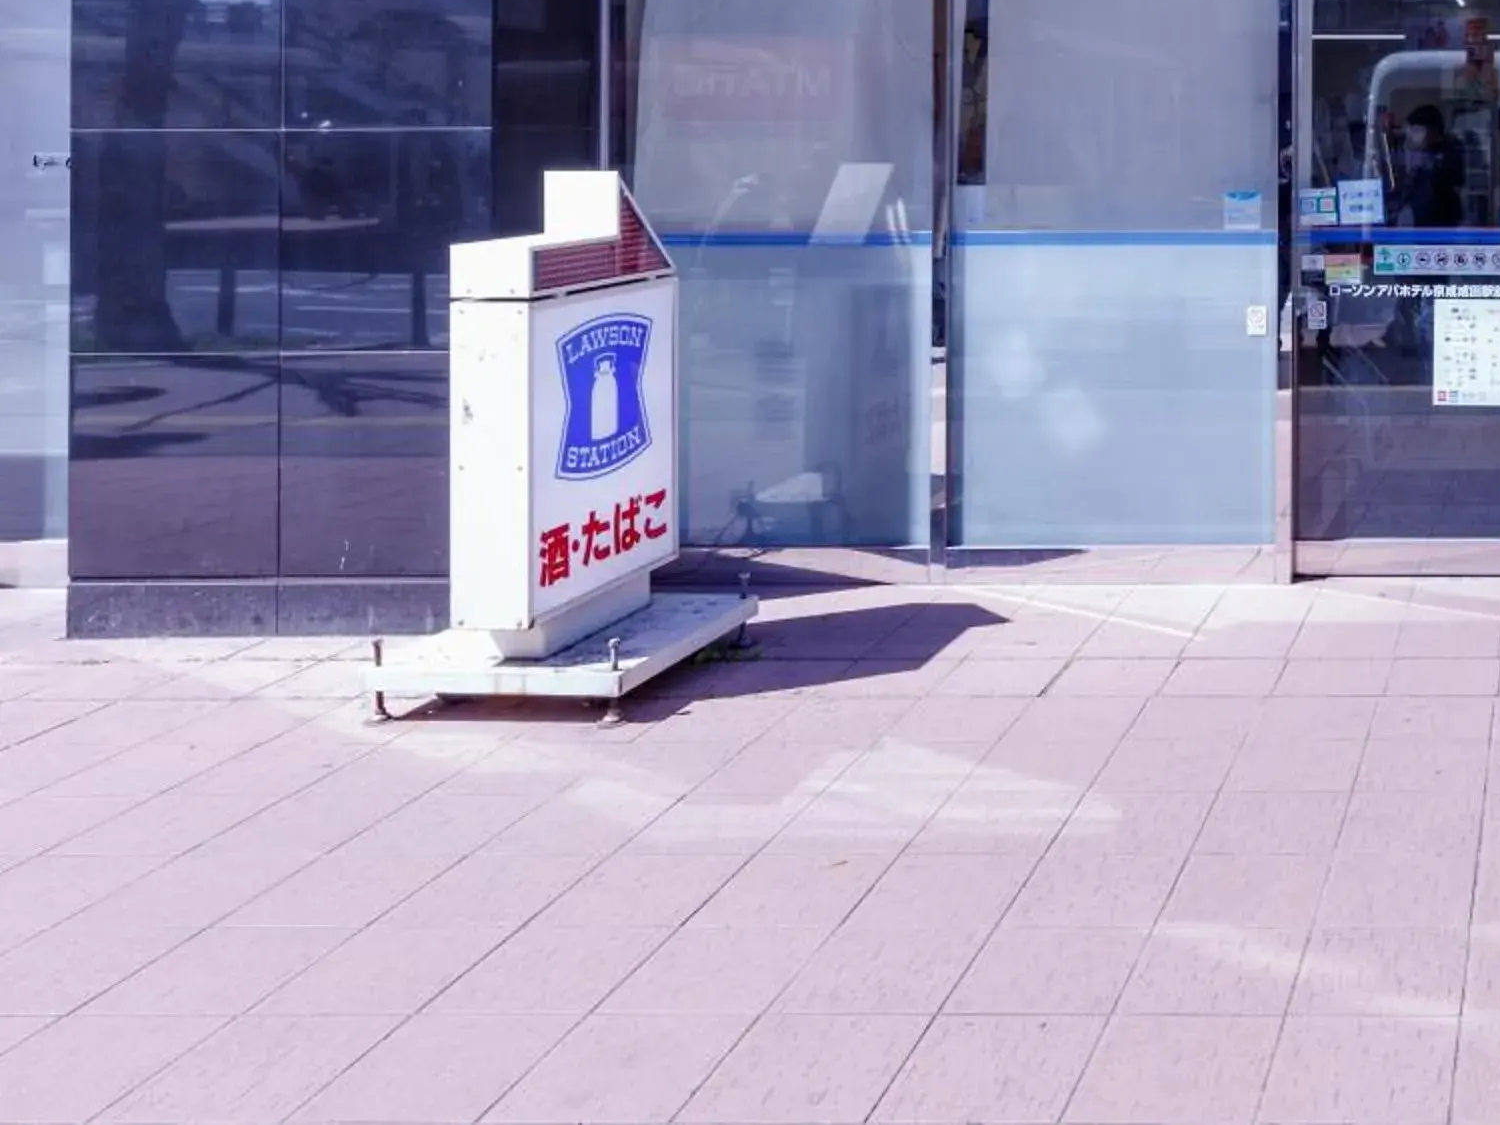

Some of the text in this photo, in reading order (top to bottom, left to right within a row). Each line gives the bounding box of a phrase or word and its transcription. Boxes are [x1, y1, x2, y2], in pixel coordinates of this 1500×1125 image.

[564, 322, 645, 366] LAWSON
[565, 425, 642, 469] STATION
[538, 488, 668, 588] 酒・たばこ
